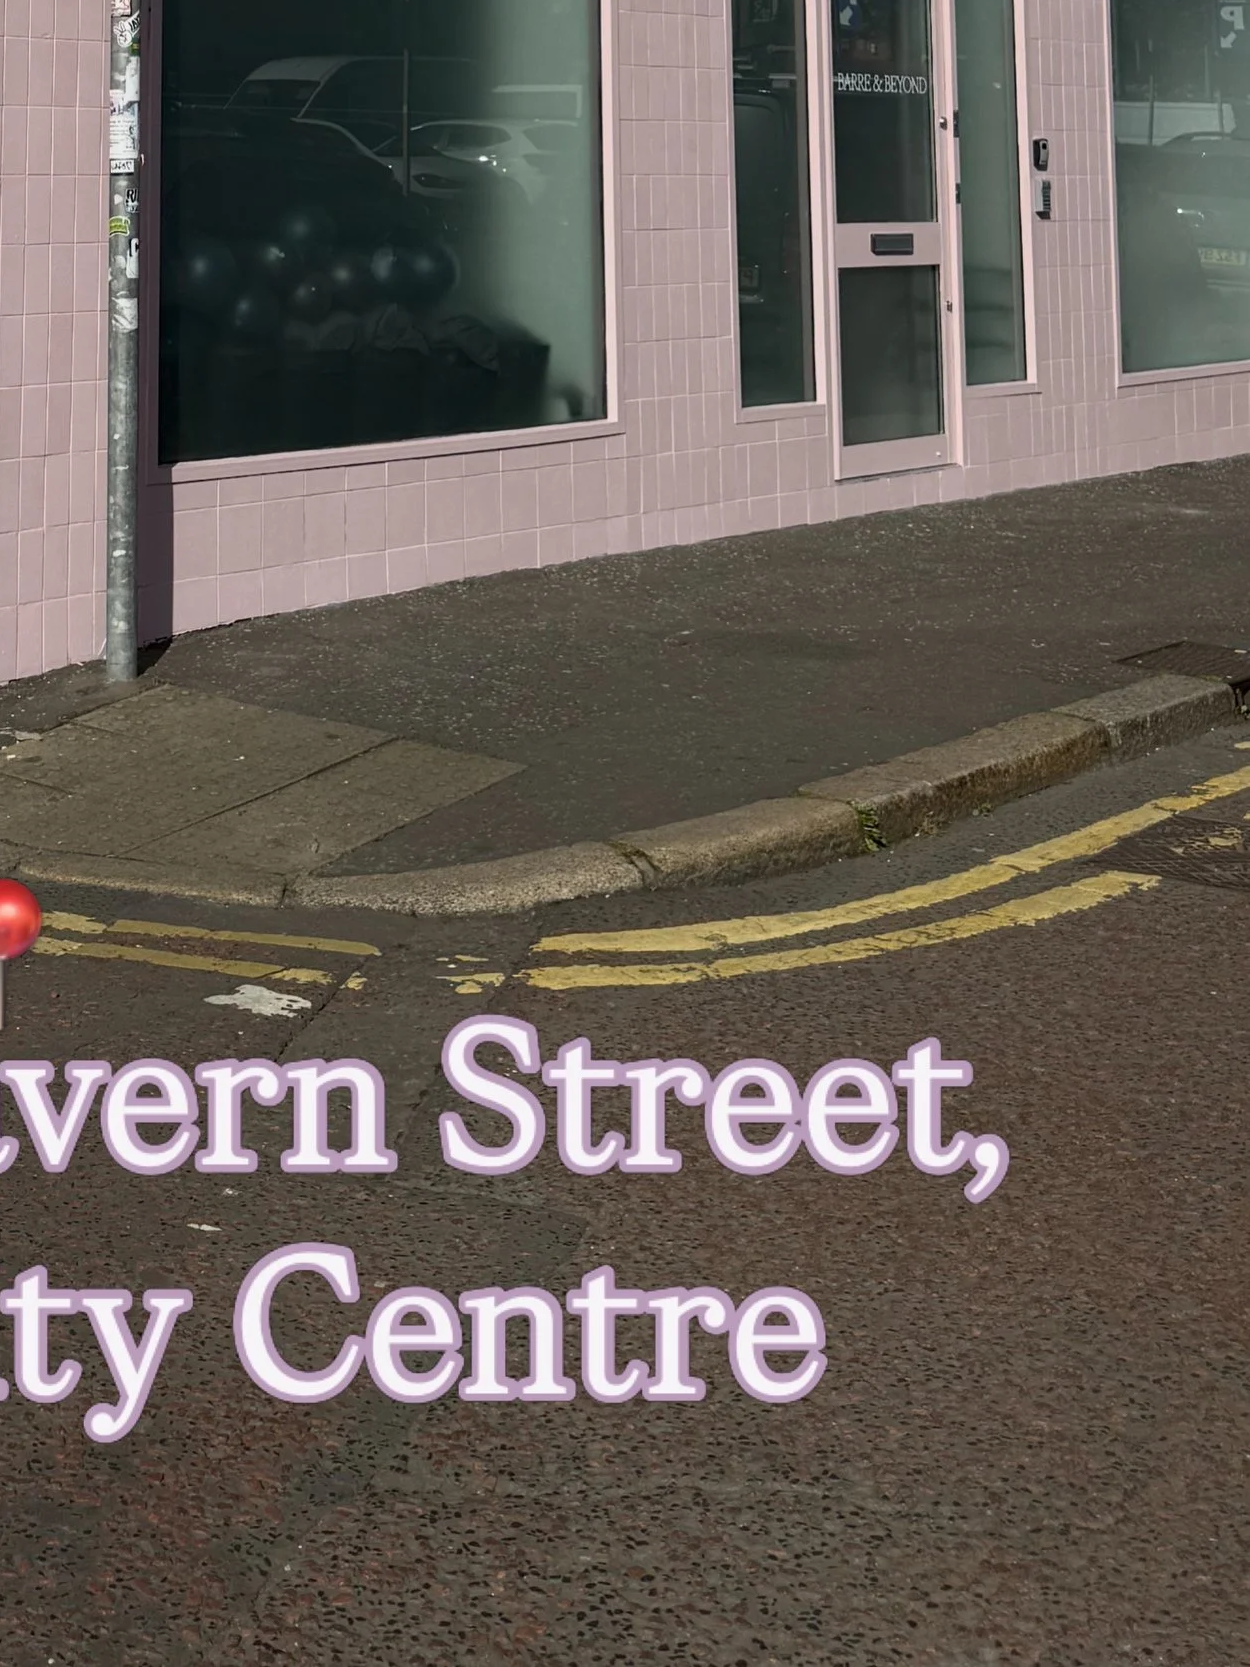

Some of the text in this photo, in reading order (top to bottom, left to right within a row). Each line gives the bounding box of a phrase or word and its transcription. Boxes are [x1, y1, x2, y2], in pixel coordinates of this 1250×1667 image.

[837, 73, 928, 94] BARRE & BEYOND
